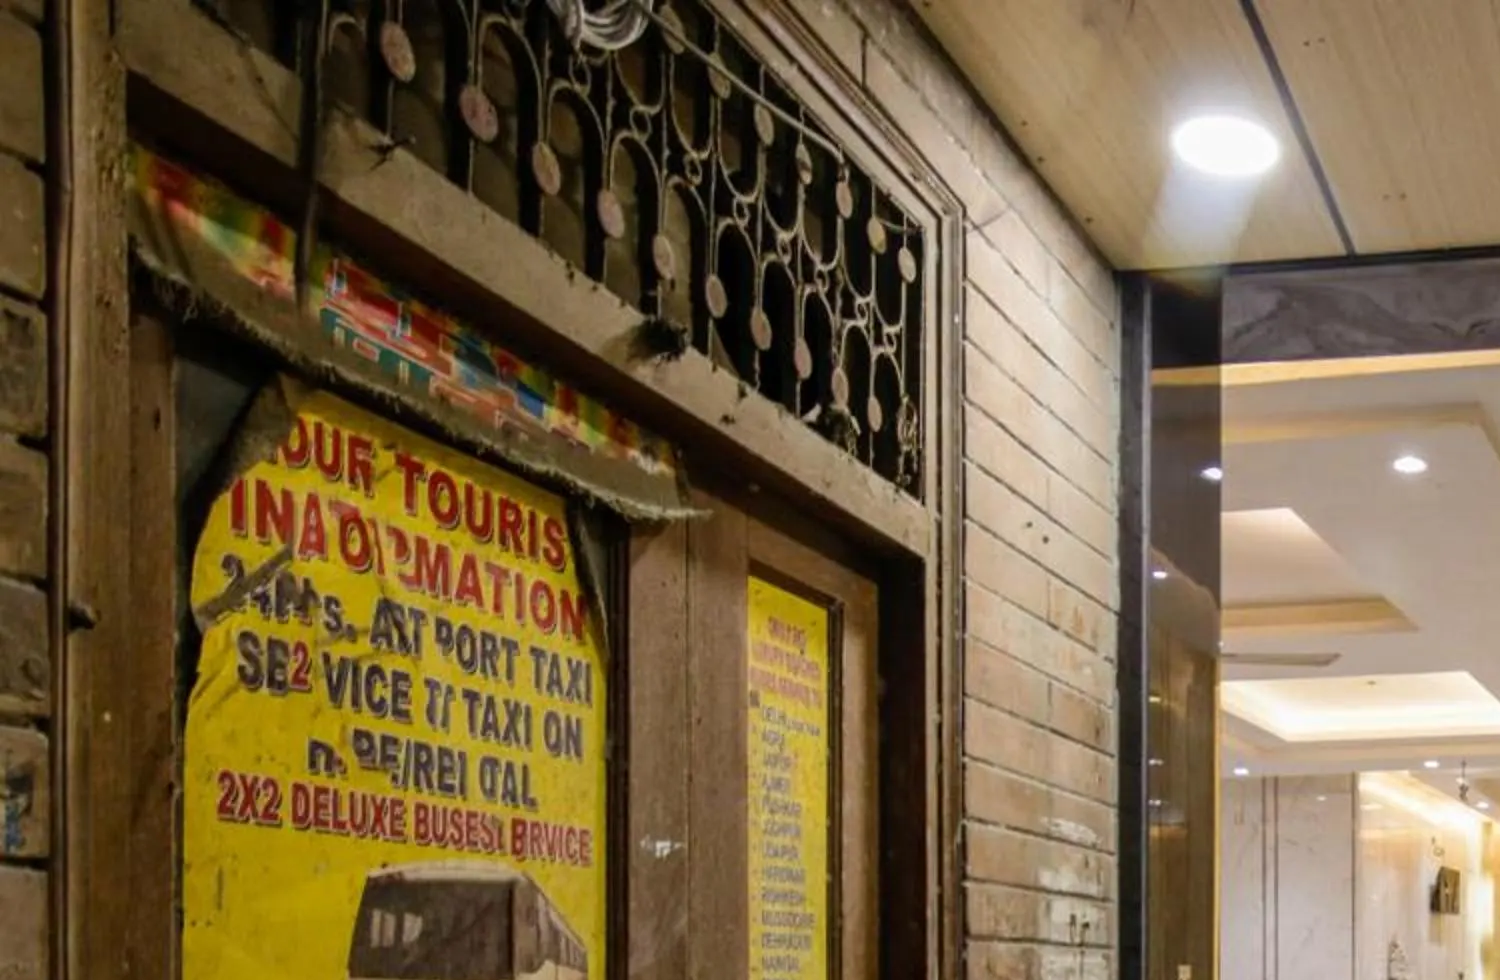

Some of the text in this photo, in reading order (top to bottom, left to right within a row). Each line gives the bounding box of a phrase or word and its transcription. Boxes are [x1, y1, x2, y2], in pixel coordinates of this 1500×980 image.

[396, 451, 566, 572] TOURIS
[530, 645, 594, 711] TAXI
[462, 687, 534, 752] TAXI
[543, 709, 584, 765] ON
[217, 769, 283, 828] 2X2
[291, 780, 408, 846] DELUXE
